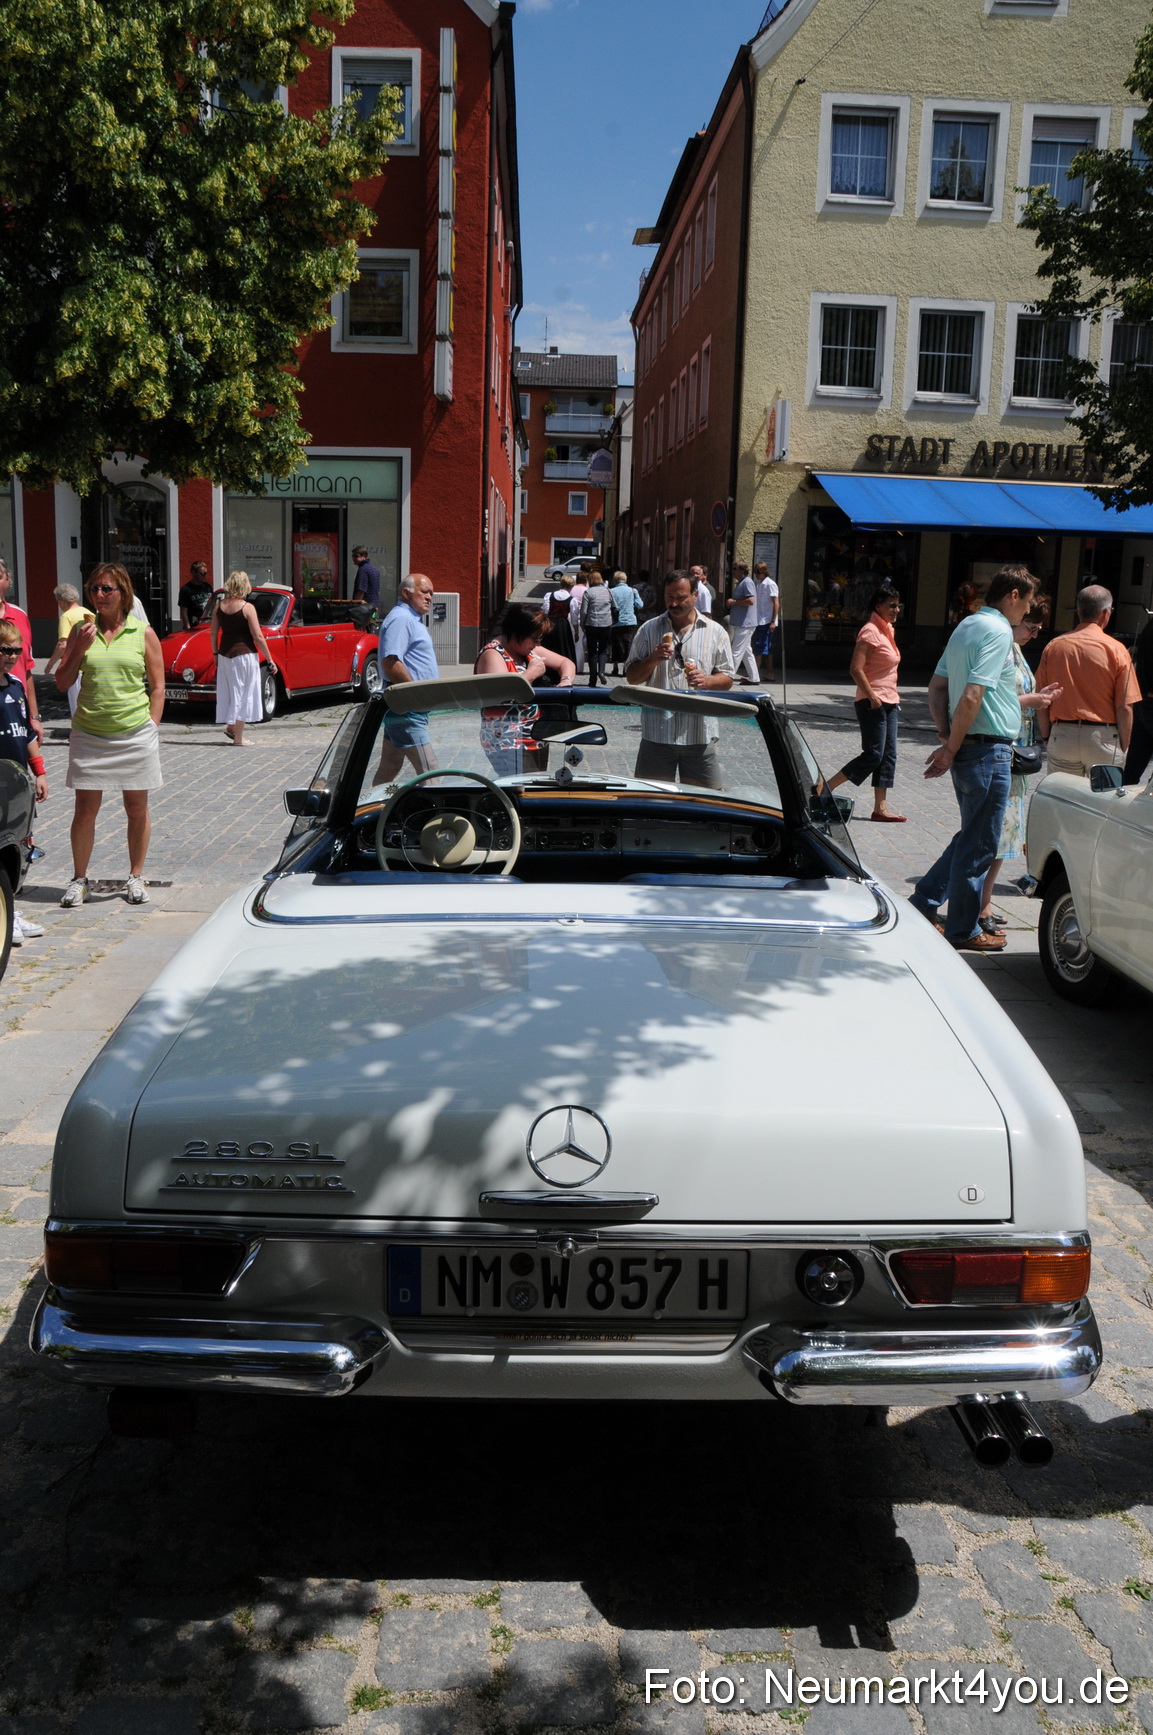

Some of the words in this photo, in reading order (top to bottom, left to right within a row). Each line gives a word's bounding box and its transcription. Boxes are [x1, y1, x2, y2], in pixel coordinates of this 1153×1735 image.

[865, 433, 955, 466] STADT
[970, 440, 1107, 474] APOTHEK
[182, 1140, 274, 1158] 280
[286, 1141, 337, 1159] SL
[171, 1172, 345, 1189] AUTOMATIC
[967, 1187, 978, 1201] D
[399, 1287, 411, 1303] D
[437, 1255, 502, 1308] NM
[541, 1257, 571, 1309] W
[586, 1257, 683, 1311] 857
[699, 1258, 729, 1310] H
